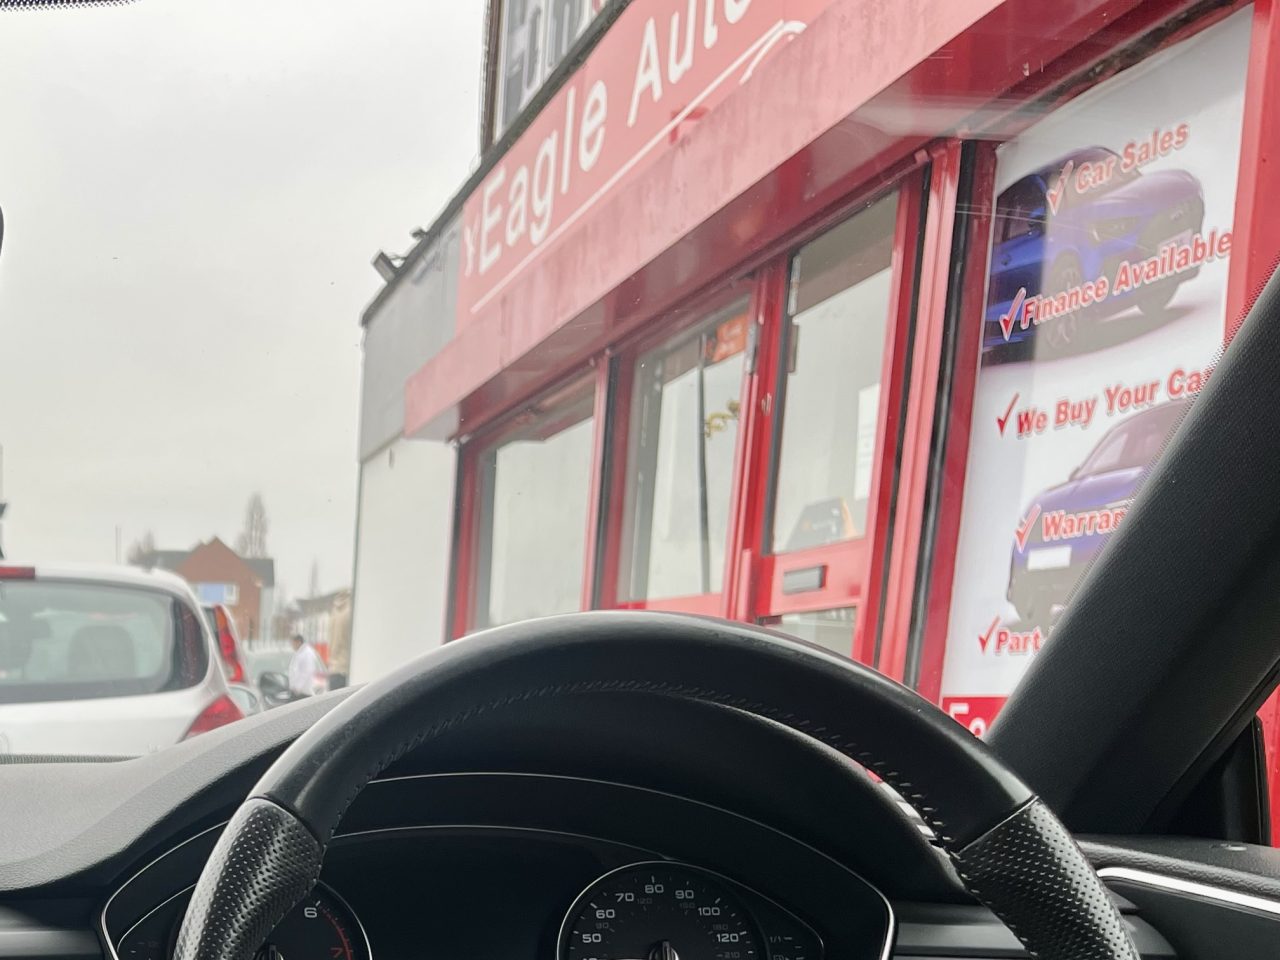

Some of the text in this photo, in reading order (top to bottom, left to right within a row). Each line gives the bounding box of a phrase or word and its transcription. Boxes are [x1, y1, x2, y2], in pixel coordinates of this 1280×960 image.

[1076, 123, 1189, 192] Car Sales
[479, 79, 608, 275] Eagle
[1021, 229, 1233, 328] Finance Available
[1016, 410, 1047, 437] We
[1054, 400, 1096, 428] Buy
[1105, 379, 1160, 416] Your
[644, 884, 664, 894] 80
[675, 889, 694, 899] 90
[615, 892, 635, 903] 70
[304, 907, 317, 918] 6
[595, 909, 615, 919] 60
[698, 906, 720, 916] 100
[582, 933, 601, 943] 50
[716, 933, 739, 943] 120
[330, 947, 343, 958] 7
